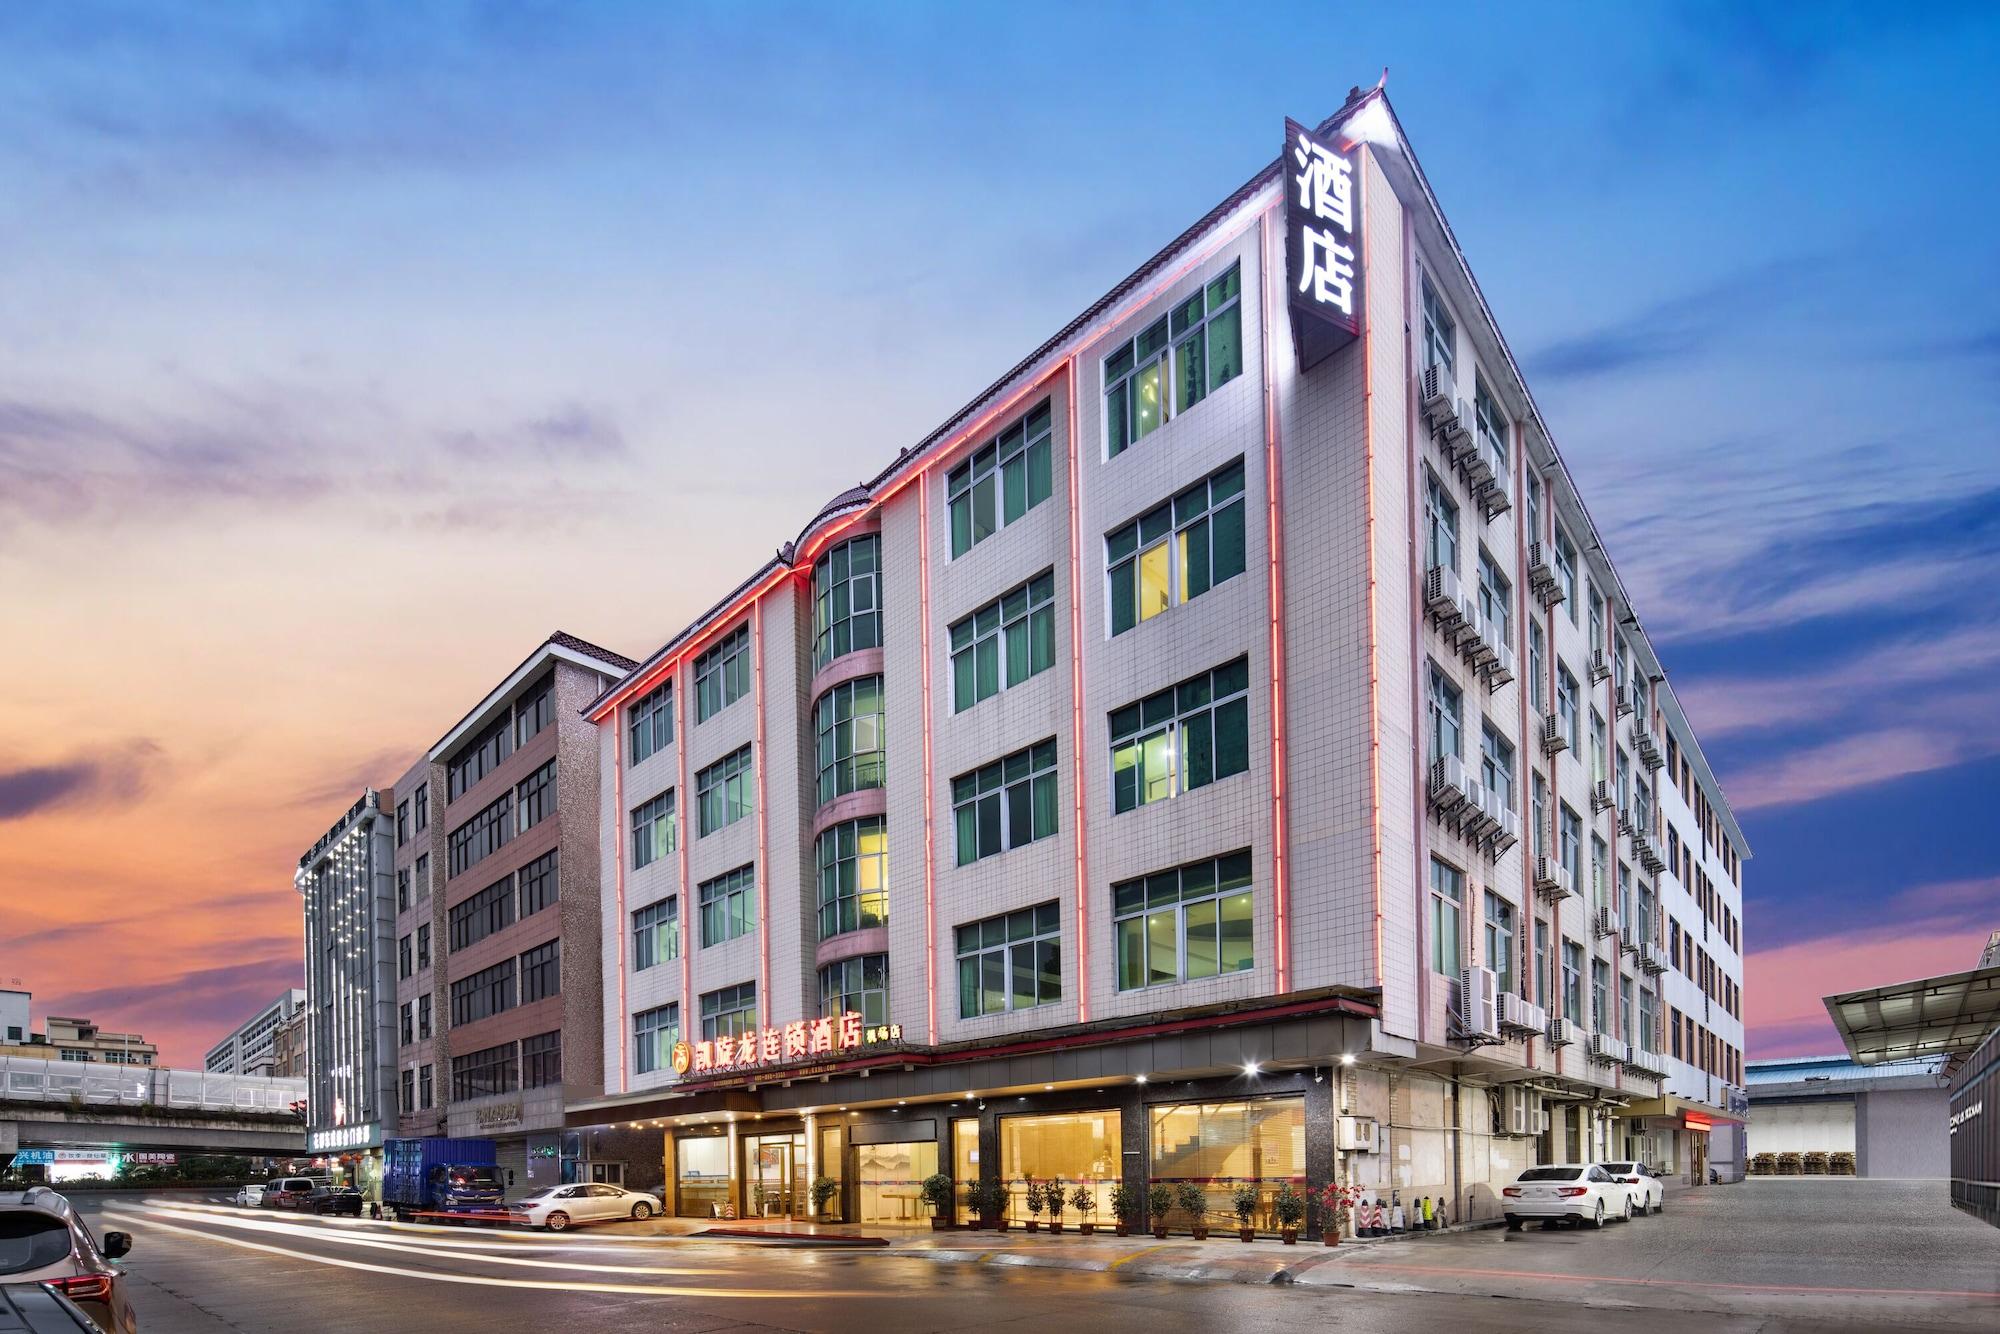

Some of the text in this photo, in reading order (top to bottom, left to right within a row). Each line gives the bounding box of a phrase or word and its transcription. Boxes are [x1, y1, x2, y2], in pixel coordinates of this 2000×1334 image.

[1295, 133, 1354, 315] 酒店
[695, 1011, 863, 1072] 凯旋龙连锁酒店
